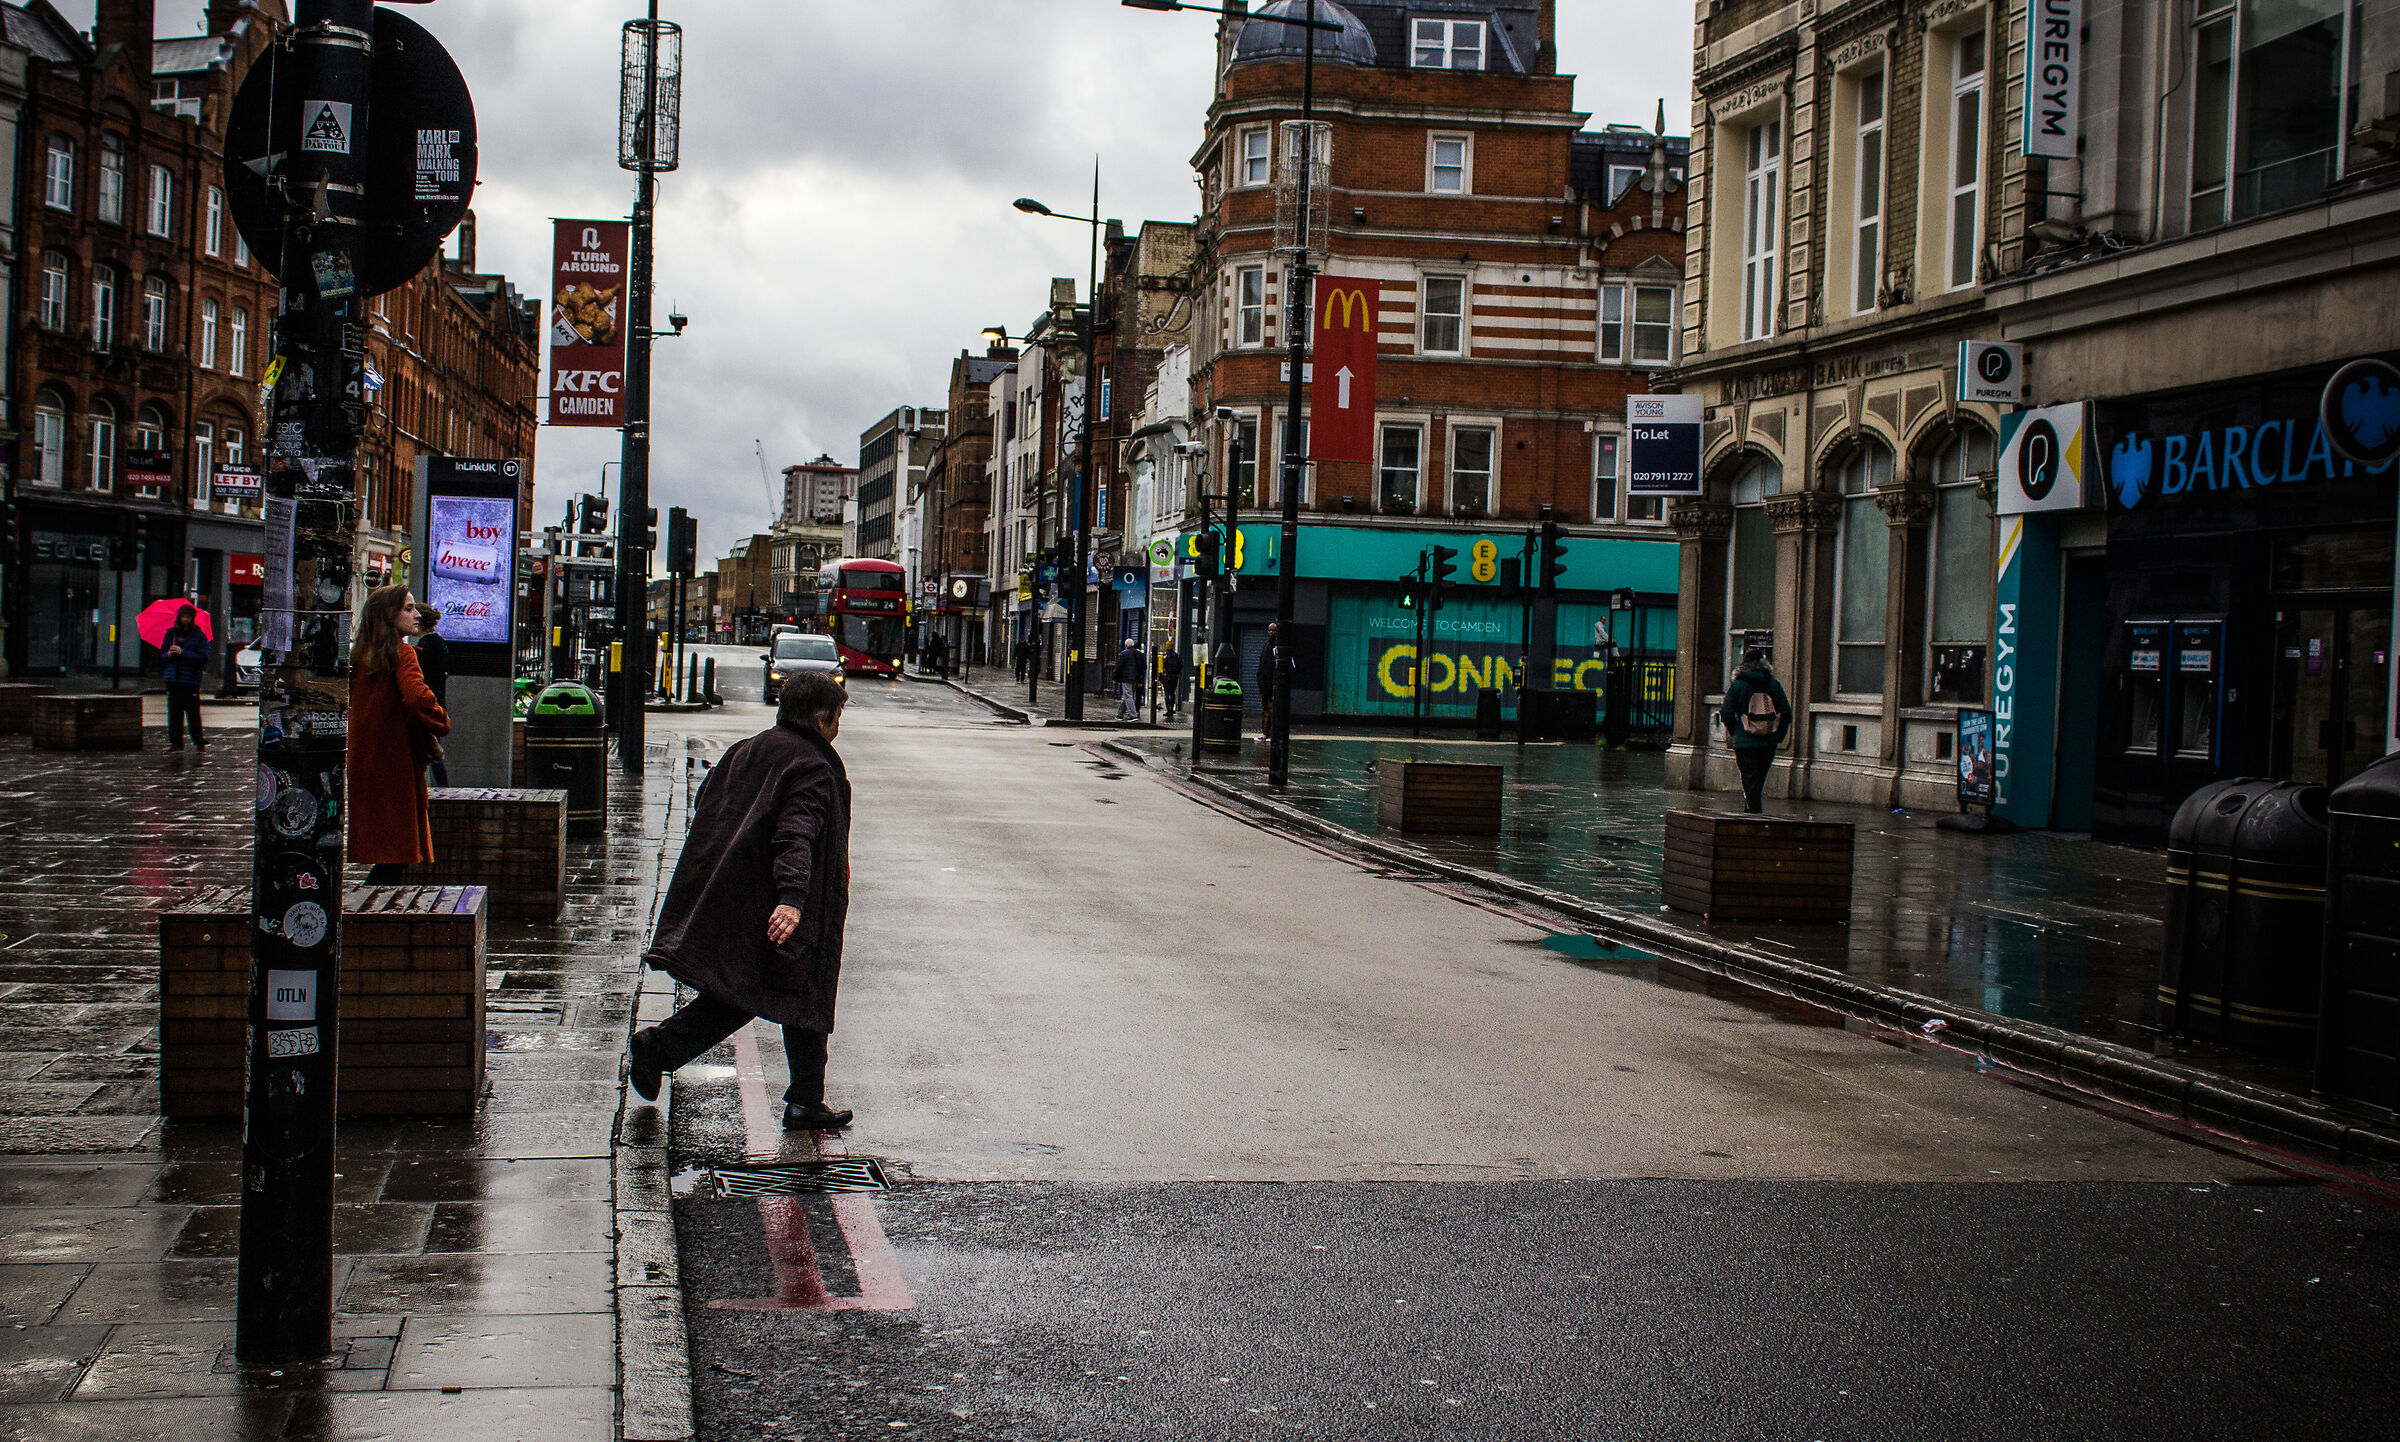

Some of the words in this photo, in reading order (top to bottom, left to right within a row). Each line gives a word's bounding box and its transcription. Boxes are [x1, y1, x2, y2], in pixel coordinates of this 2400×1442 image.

[417, 130, 447, 144] KARL
[416, 144, 451, 159] MARX
[416, 158, 460, 170] WALKING
[434, 170, 460, 182] TOUR
[571, 251, 610, 262] TURN
[560, 261, 620, 273] AROUND
[556, 323, 574, 342] KFC
[1815, 355, 1862, 386] BANK
[553, 369, 621, 393] KFC
[1976, 388, 2012, 398] PUREGYM
[559, 396, 614, 415] CAMDEN
[1633, 428, 1649, 440] To
[1650, 428, 1669, 440] Let
[2161, 415, 2392, 495] BARCLA
[222, 464, 250, 473] Bruce
[455, 461, 496, 472] InLinkUK
[214, 475, 239, 484] LET
[242, 476, 260, 485] BY
[1633, 472, 1650, 480] 020
[1650, 472, 1671, 480] 7911
[1672, 472, 1693, 480] 2727
[466, 520, 502, 545] boy
[440, 550, 491, 571] byeeee
[445, 602, 467, 615] Diet
[465, 601, 491, 617] Coke
[884, 601, 895, 609] 24
[1435, 620, 1450, 630] TO
[1451, 620, 1500, 632] CAMDEN
[1994, 603, 2017, 805] PUREGYM
[312, 711, 340, 720] ROCK
[277, 988, 307, 1003] OTLN
